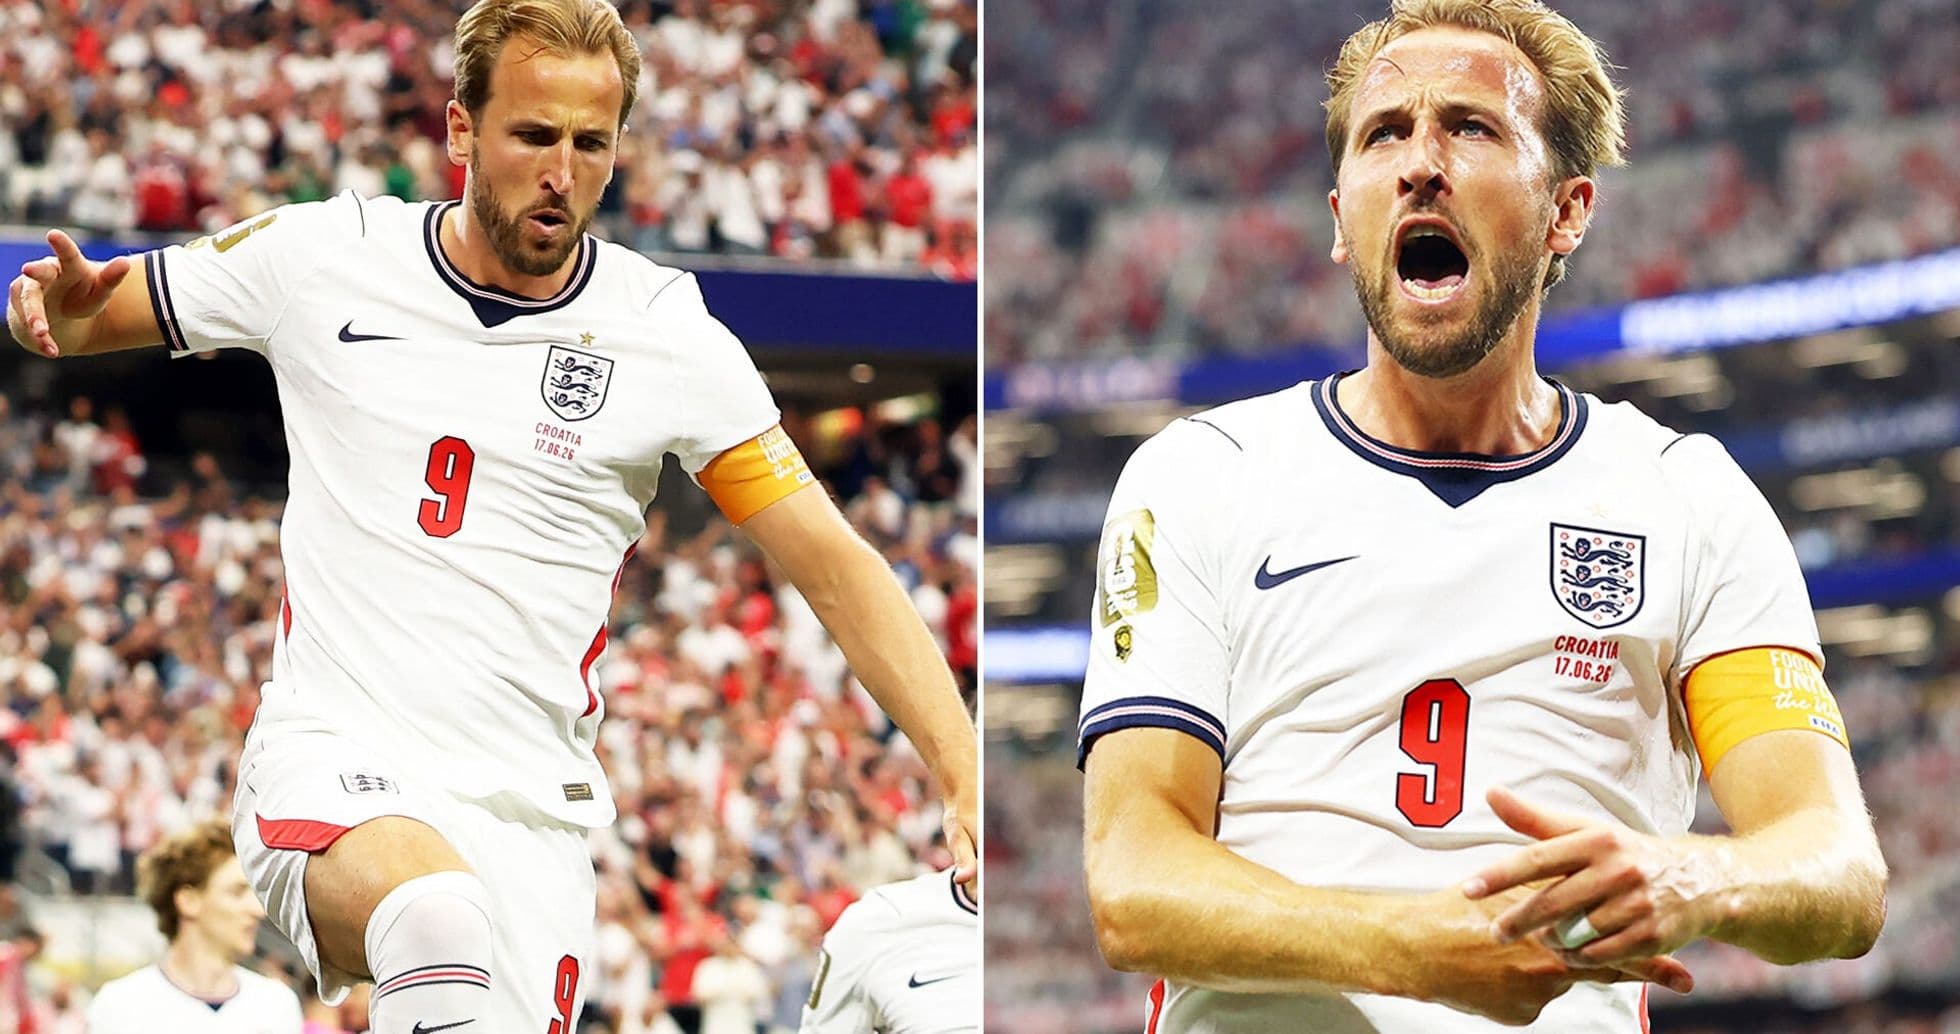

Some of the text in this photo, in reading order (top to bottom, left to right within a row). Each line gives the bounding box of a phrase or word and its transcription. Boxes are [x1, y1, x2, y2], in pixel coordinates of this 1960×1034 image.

[535, 422, 581, 446] CROATIA
[534, 438, 575, 461] 17.06.26
[417, 435, 475, 538] 9
[1554, 635, 1619, 659] CROATIA
[1555, 656, 1612, 682] 17.06.26
[1396, 678, 1471, 828] 9
[547, 954, 579, 1034] 9
